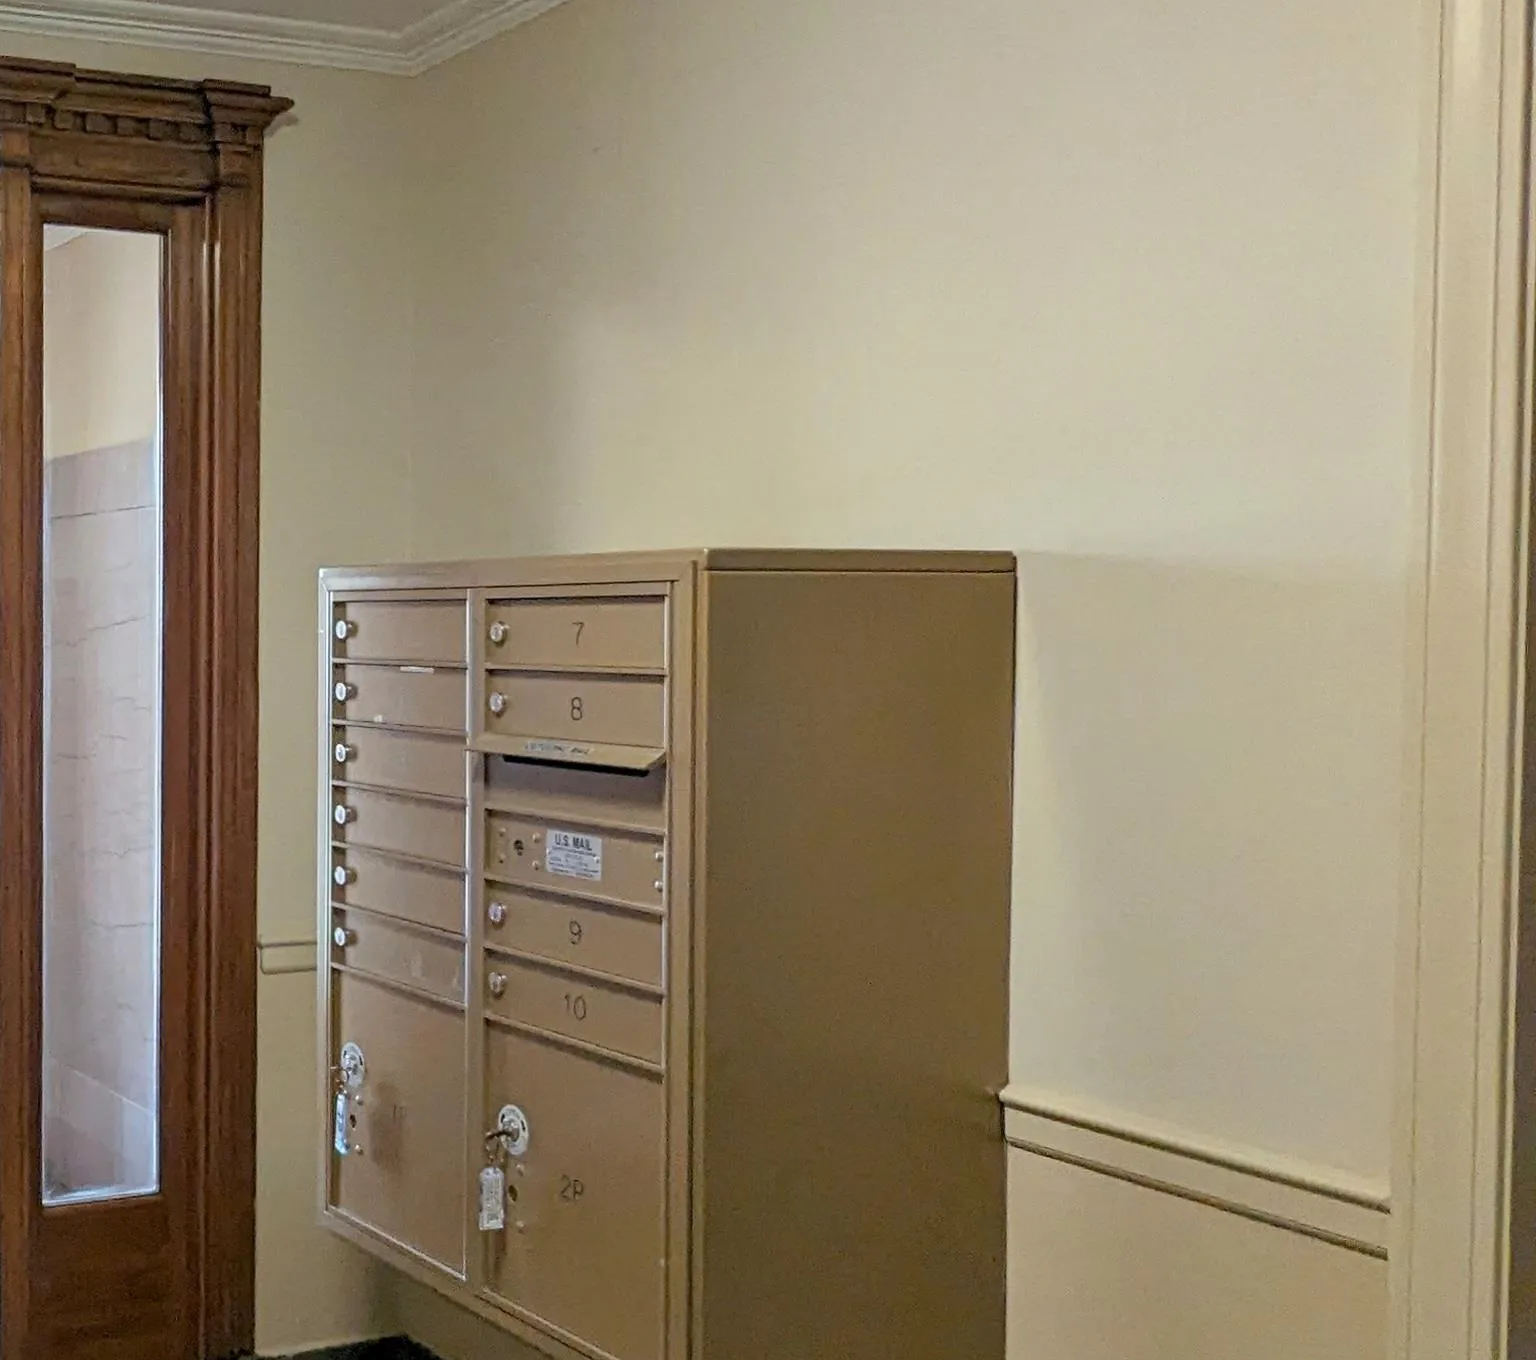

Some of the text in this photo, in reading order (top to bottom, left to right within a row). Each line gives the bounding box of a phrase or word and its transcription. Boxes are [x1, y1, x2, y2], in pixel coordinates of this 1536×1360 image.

[572, 621, 584, 645] 7
[570, 696, 583, 721] 8
[568, 919, 582, 945] 9
[564, 993, 587, 1021] 10
[560, 1174, 585, 1202] 2P
